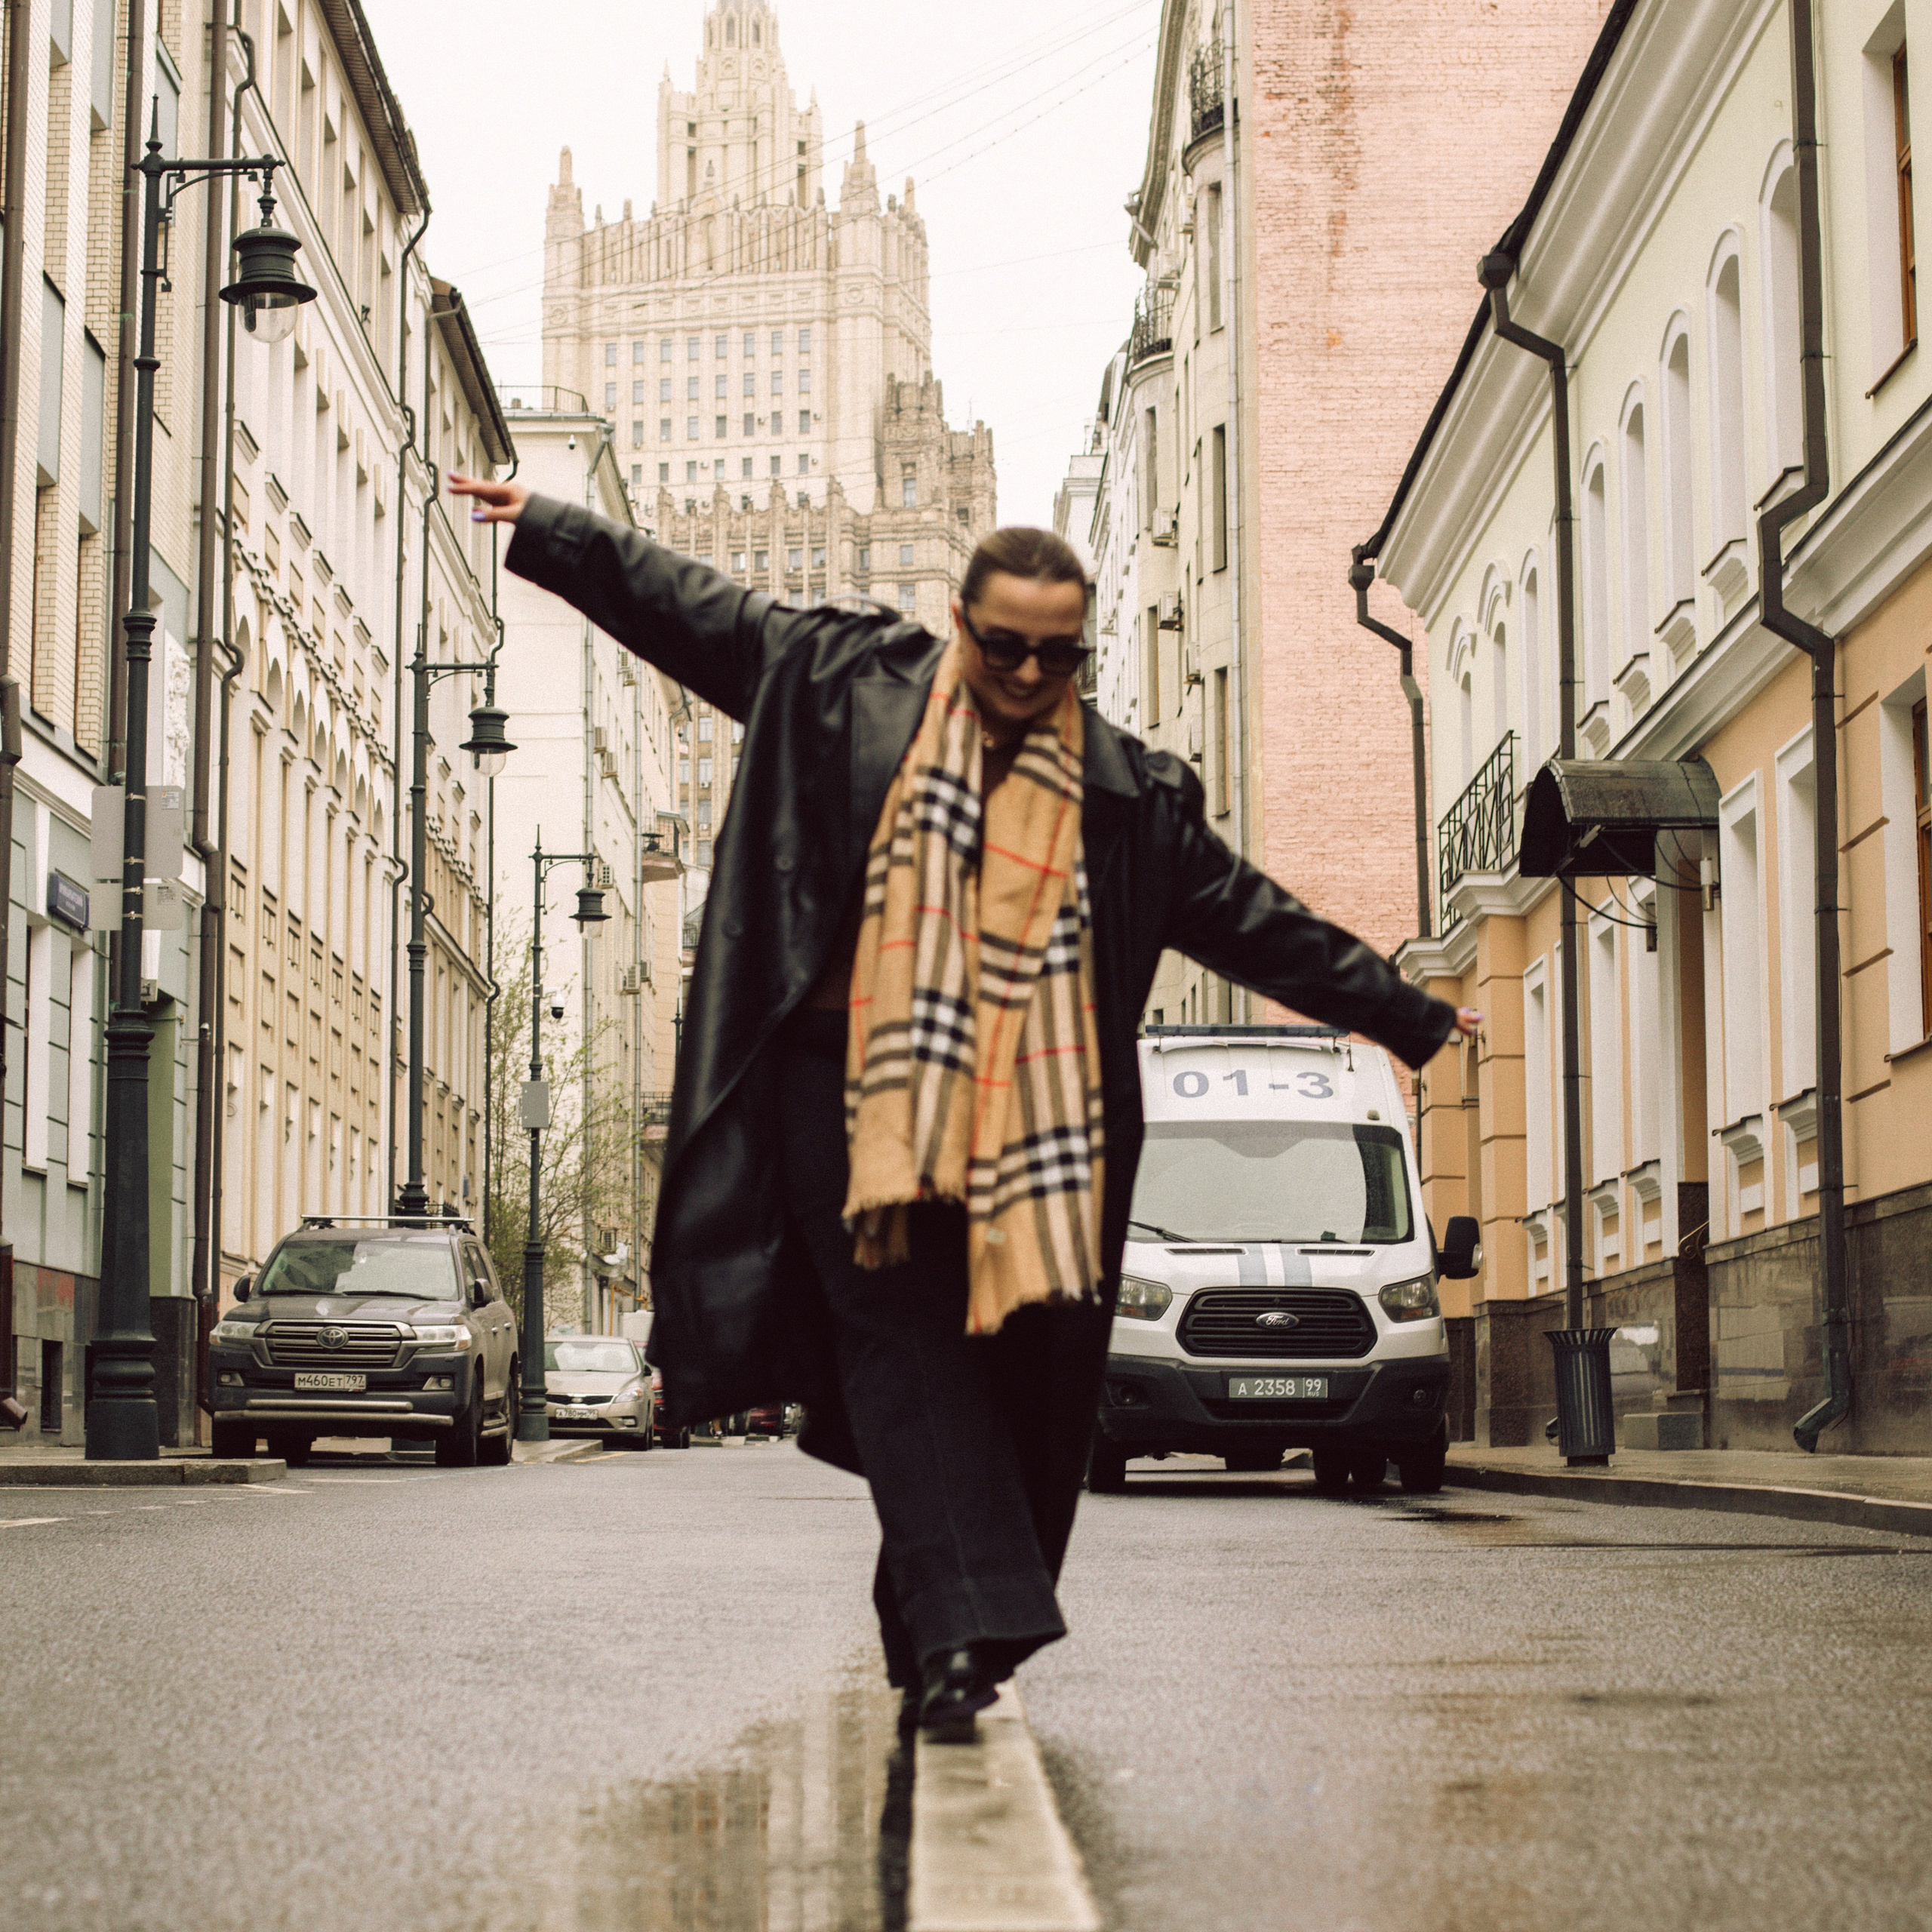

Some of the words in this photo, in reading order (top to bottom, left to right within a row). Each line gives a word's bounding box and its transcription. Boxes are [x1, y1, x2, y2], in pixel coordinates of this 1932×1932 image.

[1266, 1315, 1290, 1326] Ford
[346, 1375, 363, 1383] 797
[1254, 1380, 1295, 1395] 2358
[1306, 1379, 1321, 1391] 99
